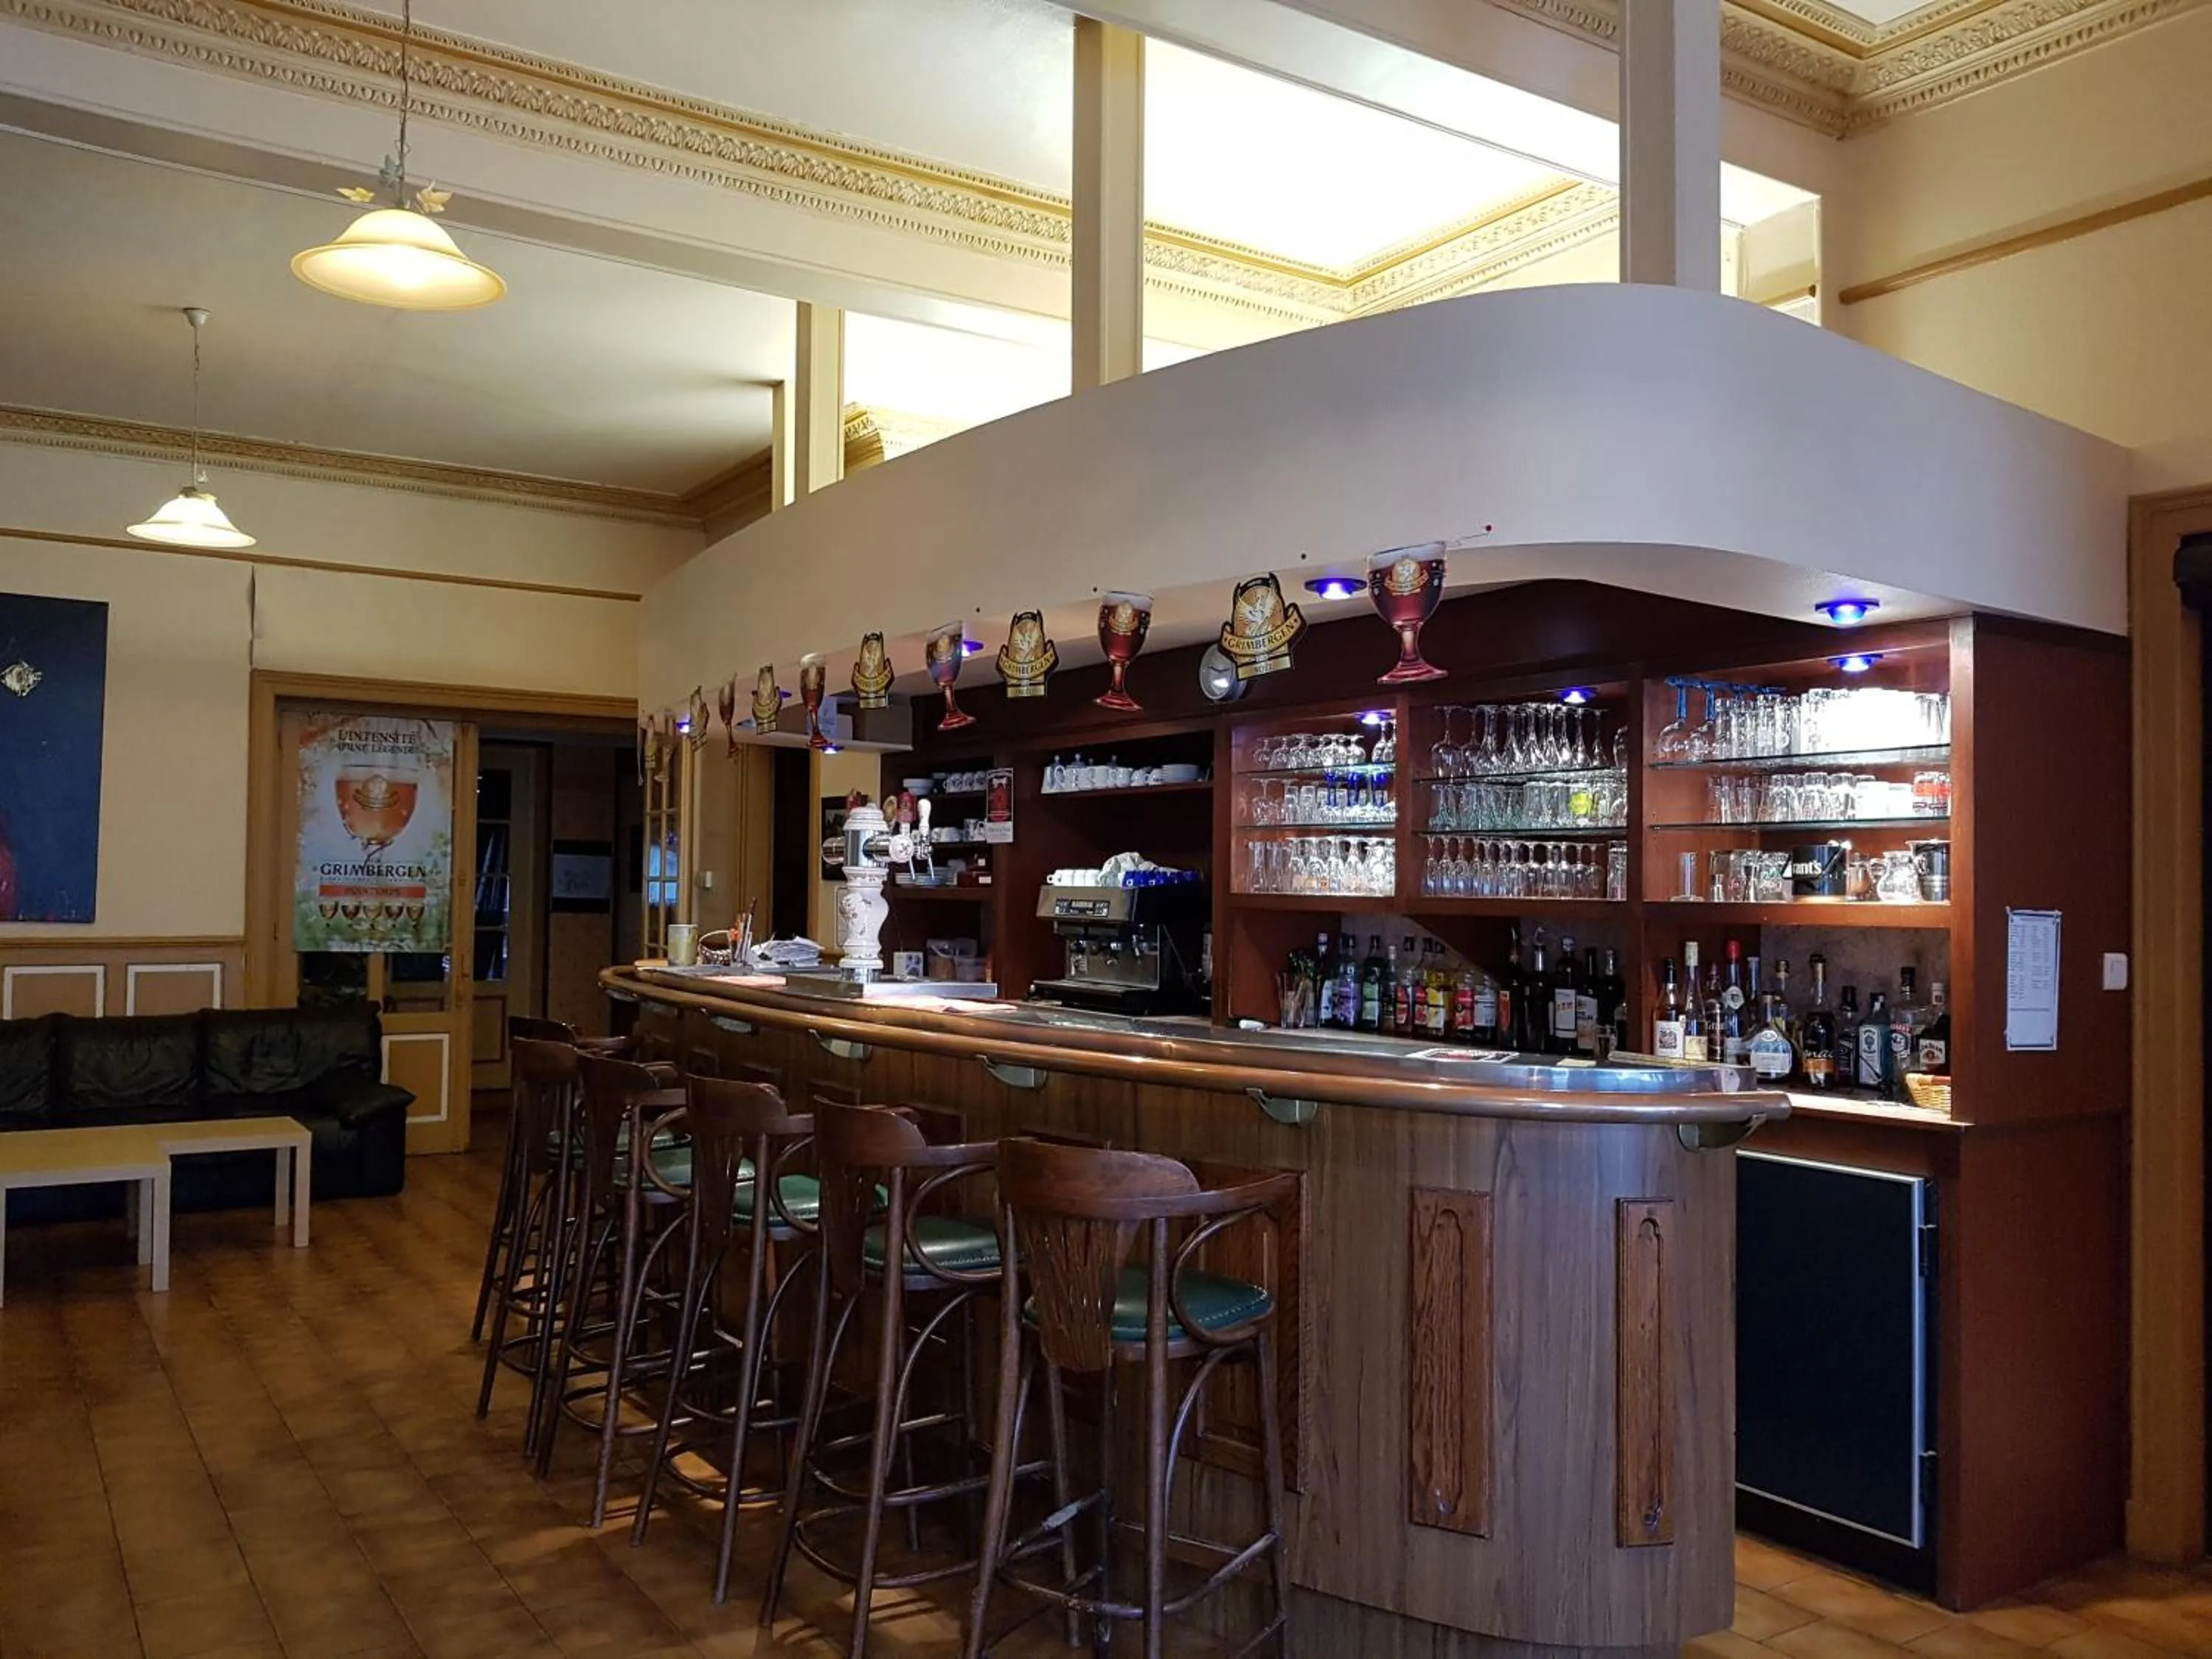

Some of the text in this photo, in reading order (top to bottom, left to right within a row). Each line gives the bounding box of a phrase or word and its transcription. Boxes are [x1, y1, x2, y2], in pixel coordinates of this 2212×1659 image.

[1228, 624, 1295, 650] GRIMBERGEN
[320, 862, 426, 877] GRIMBERGEN
[1792, 860, 1822, 874] rant's
